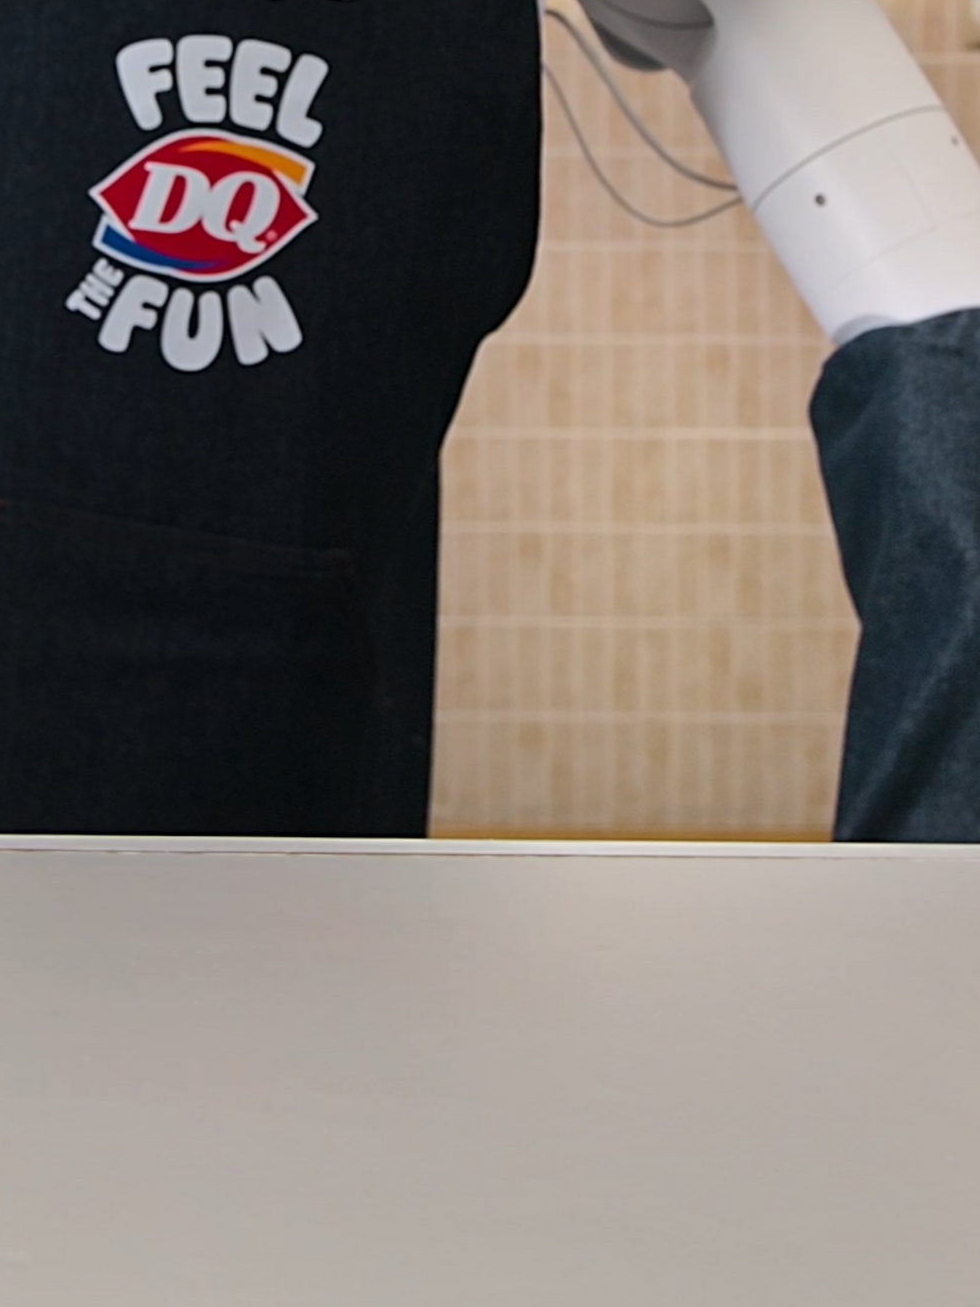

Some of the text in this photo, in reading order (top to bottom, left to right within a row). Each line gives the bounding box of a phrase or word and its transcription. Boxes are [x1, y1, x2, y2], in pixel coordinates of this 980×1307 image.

[116, 34, 329, 148] FEEL
[128, 161, 281, 254] DQ
[65, 257, 303, 372] THE FUN
